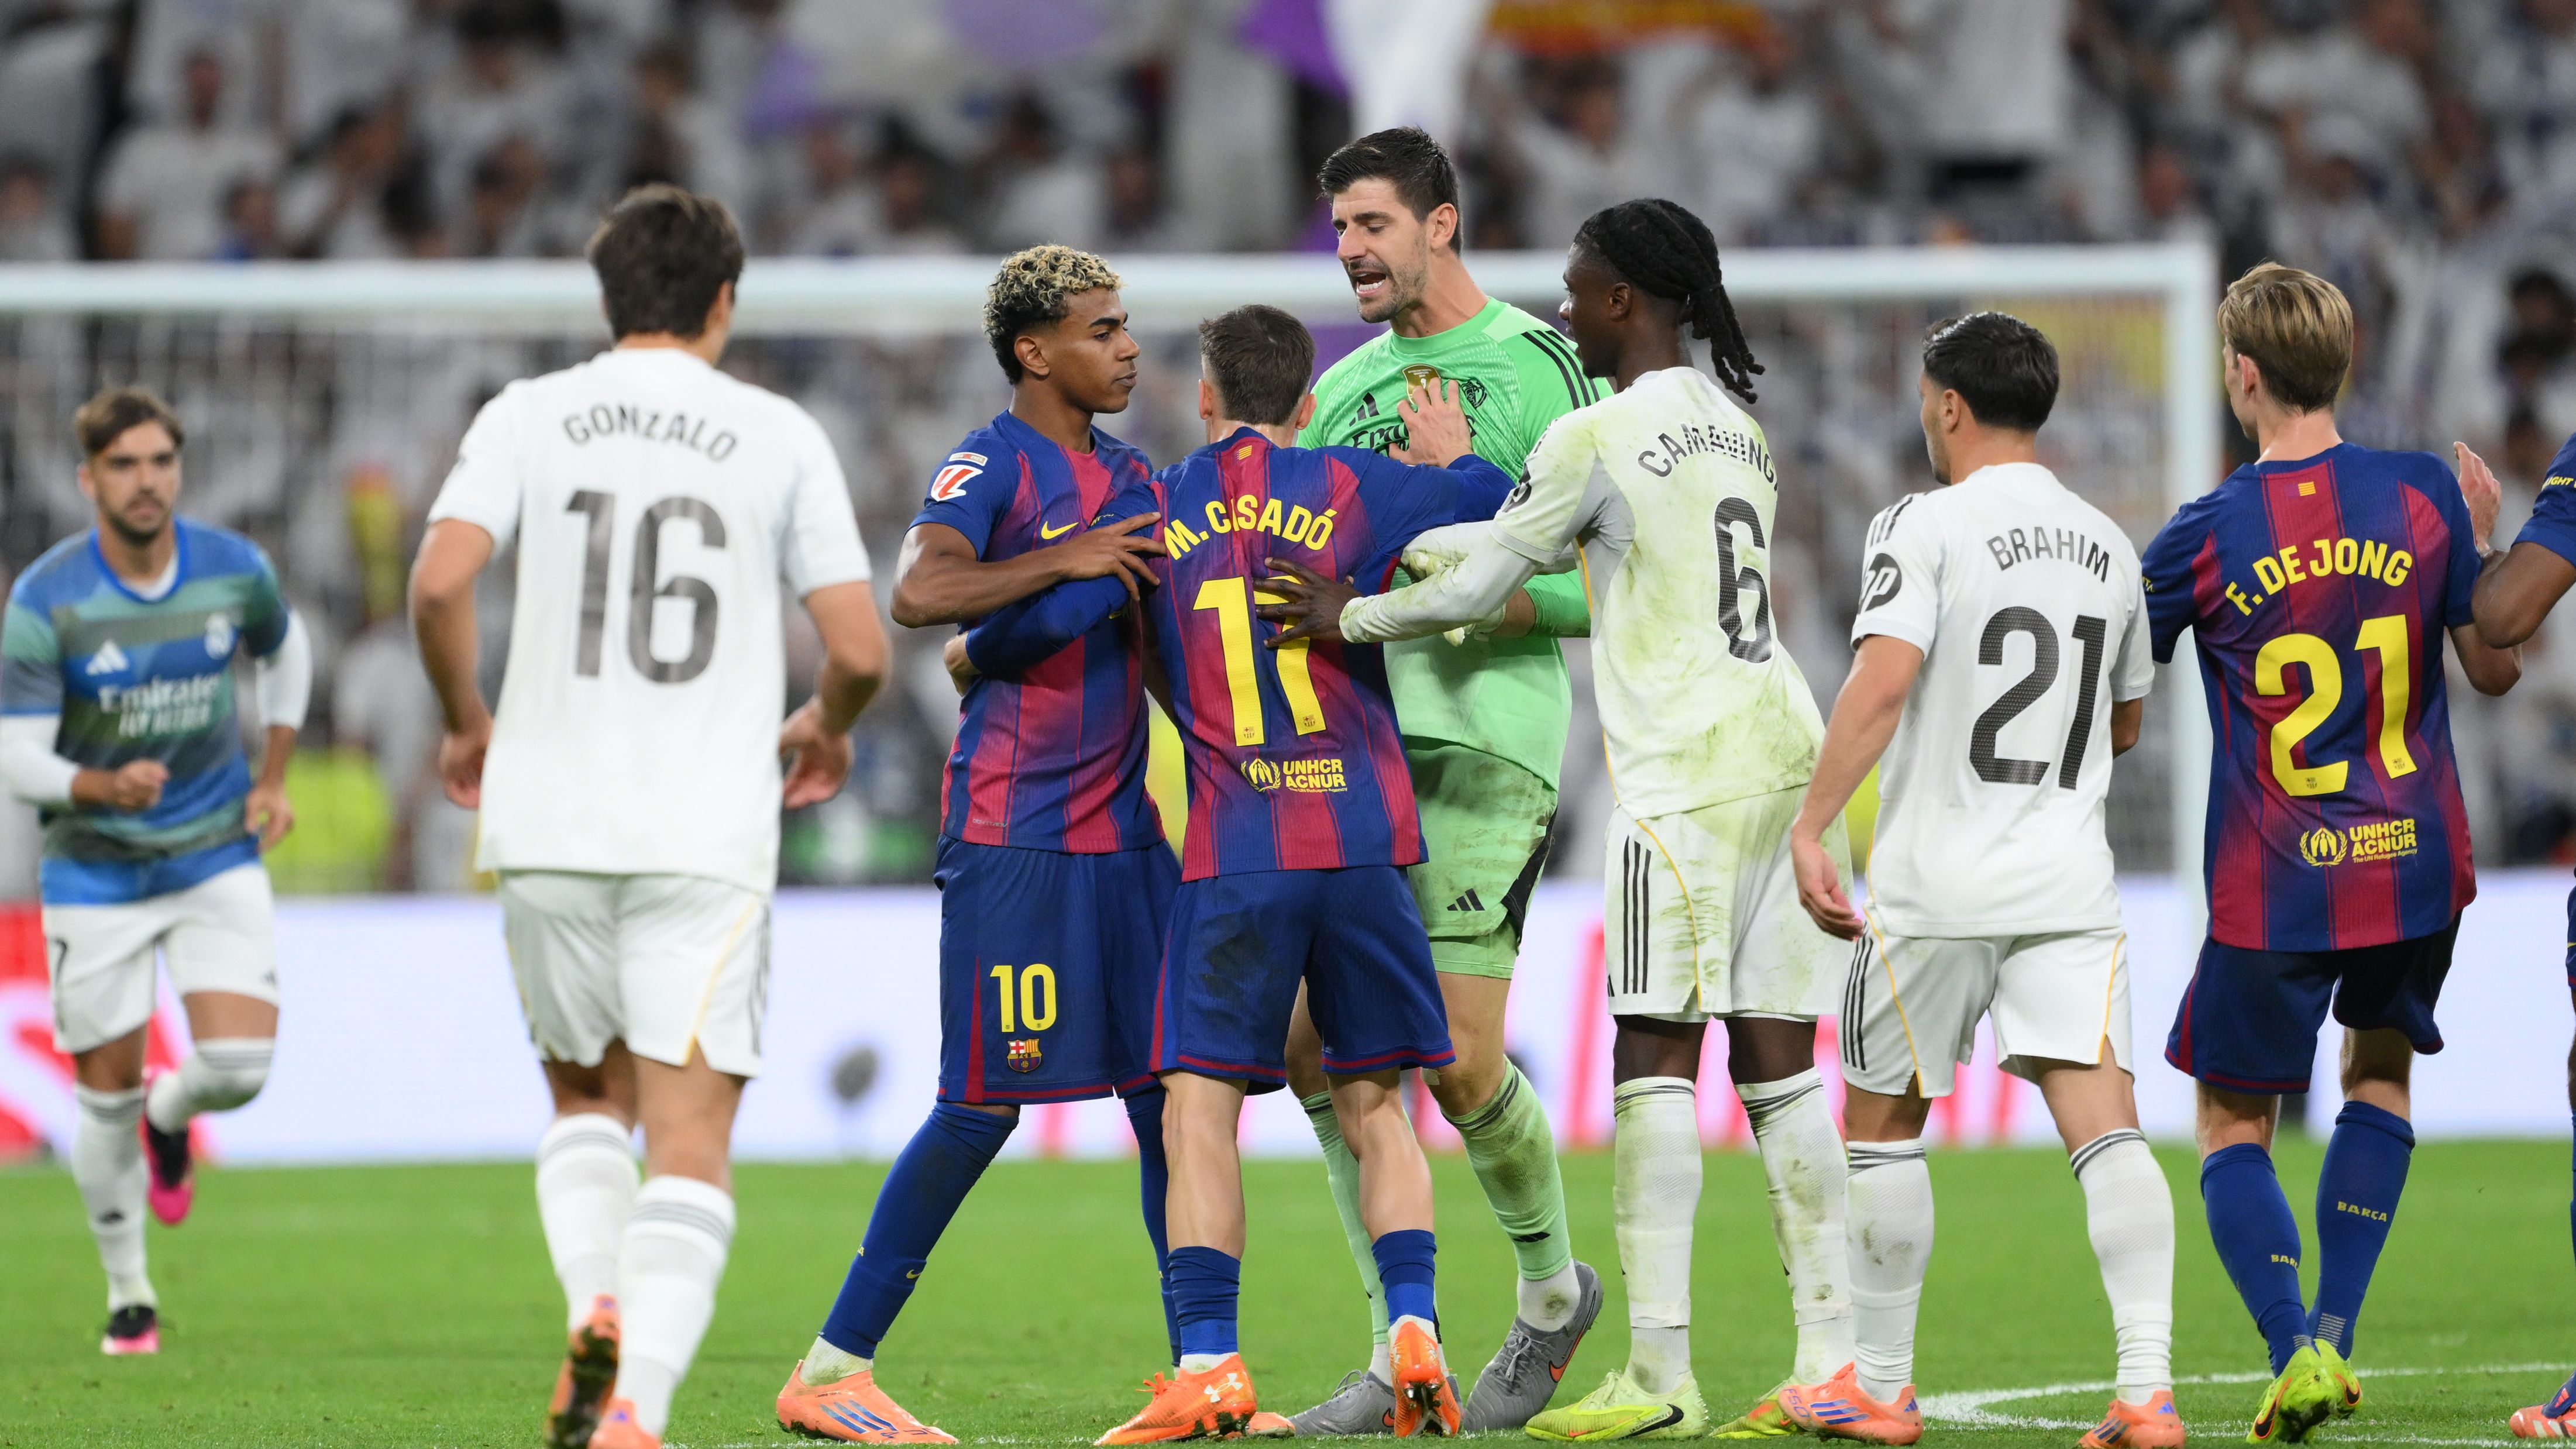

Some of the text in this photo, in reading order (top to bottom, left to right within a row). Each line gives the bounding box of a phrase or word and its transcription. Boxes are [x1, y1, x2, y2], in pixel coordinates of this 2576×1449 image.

[562, 404, 737, 462] GONZALO
[1638, 422, 1777, 492] CAMAVING
[1164, 494, 1337, 560] M. CSADÓ
[1986, 526, 2110, 583] BRAHIM
[564, 489, 727, 683] 16
[1714, 497, 1773, 663] 6
[2226, 538, 2413, 617] F. DE JONG
[1193, 574, 1327, 747] 17
[1969, 605, 2107, 791] 21
[2255, 614, 2418, 797] 21
[1283, 759, 1343, 775] UNHCR
[1286, 774, 1346, 788] ACNUR
[2350, 819, 2415, 841] UNHCR
[2353, 833, 2417, 856] ACNUR
[2398, 848, 2417, 856] Agency
[990, 963, 1057, 1032] 10
[2337, 1201, 2388, 1222] BARÇA
